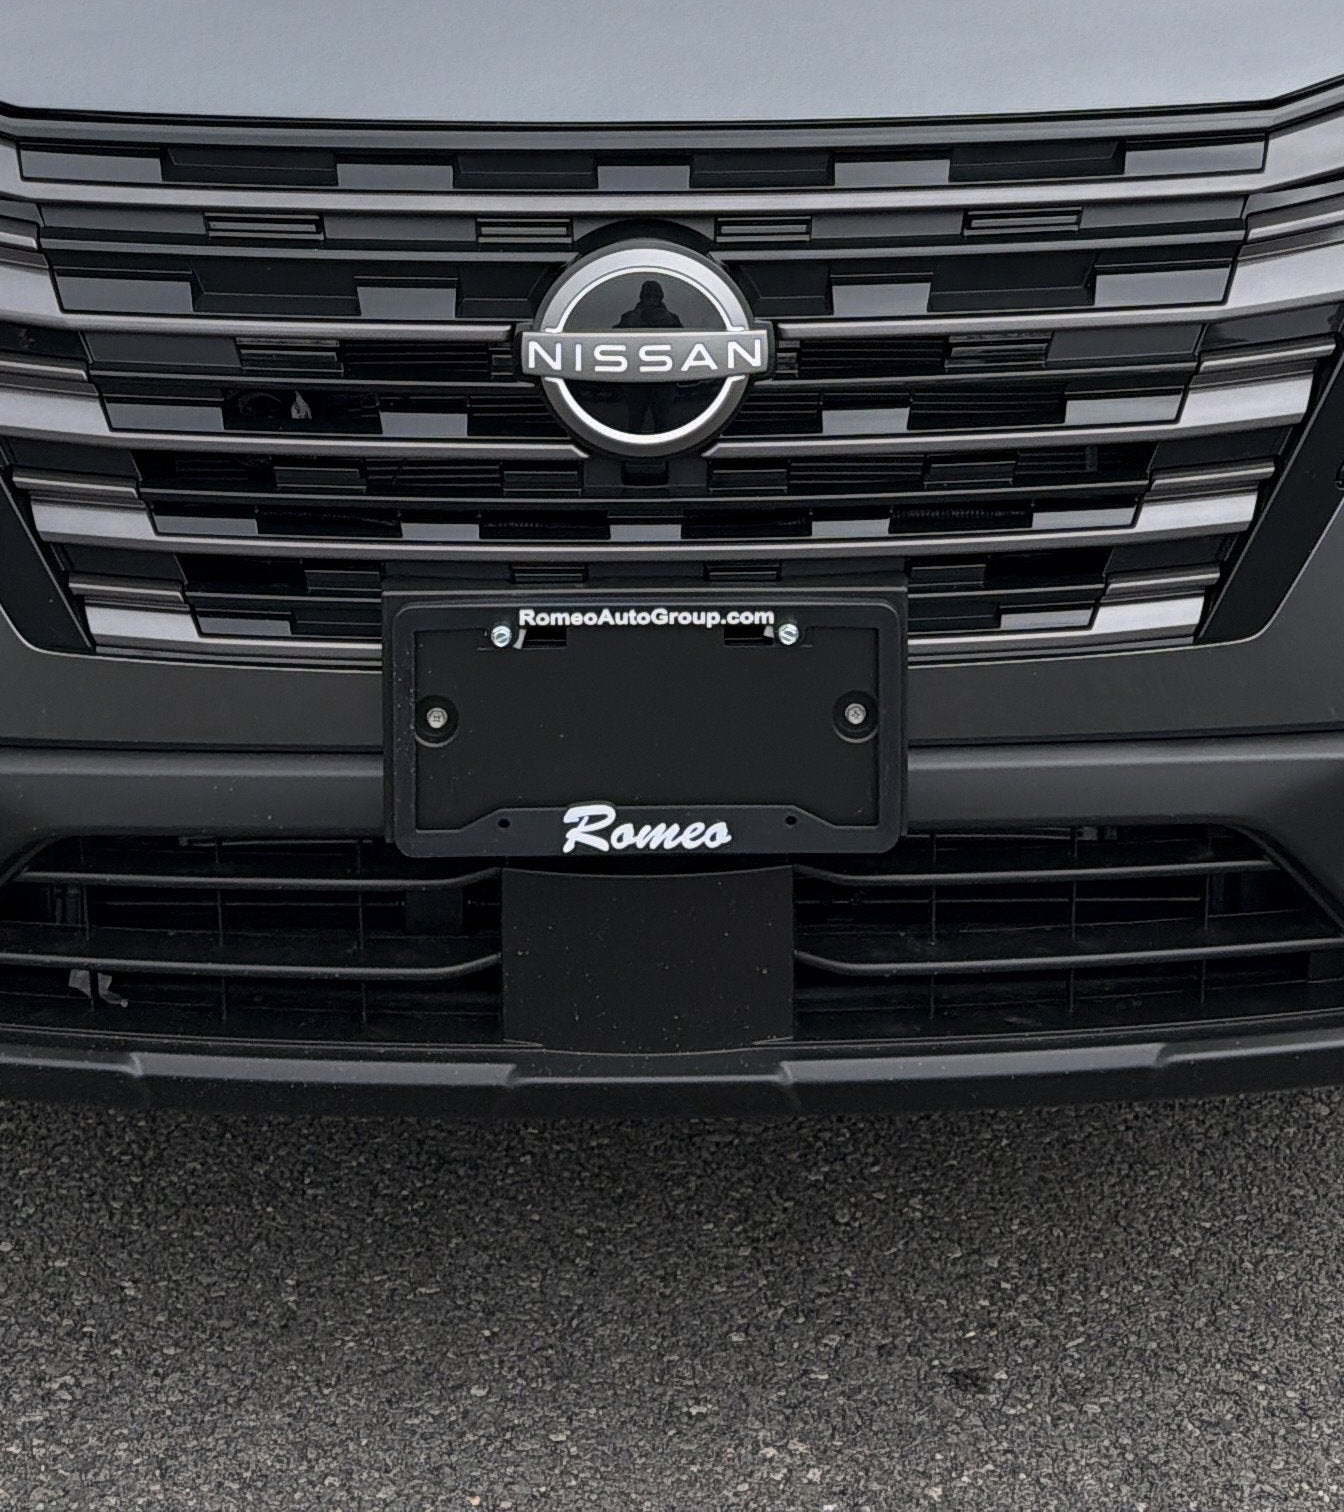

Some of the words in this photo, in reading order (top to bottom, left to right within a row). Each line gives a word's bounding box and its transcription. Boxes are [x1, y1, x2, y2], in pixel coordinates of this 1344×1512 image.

[528, 339, 762, 372] NISSAN
[518, 607, 776, 628] RomeoAutoGroup.com
[562, 804, 733, 854] Romeo
